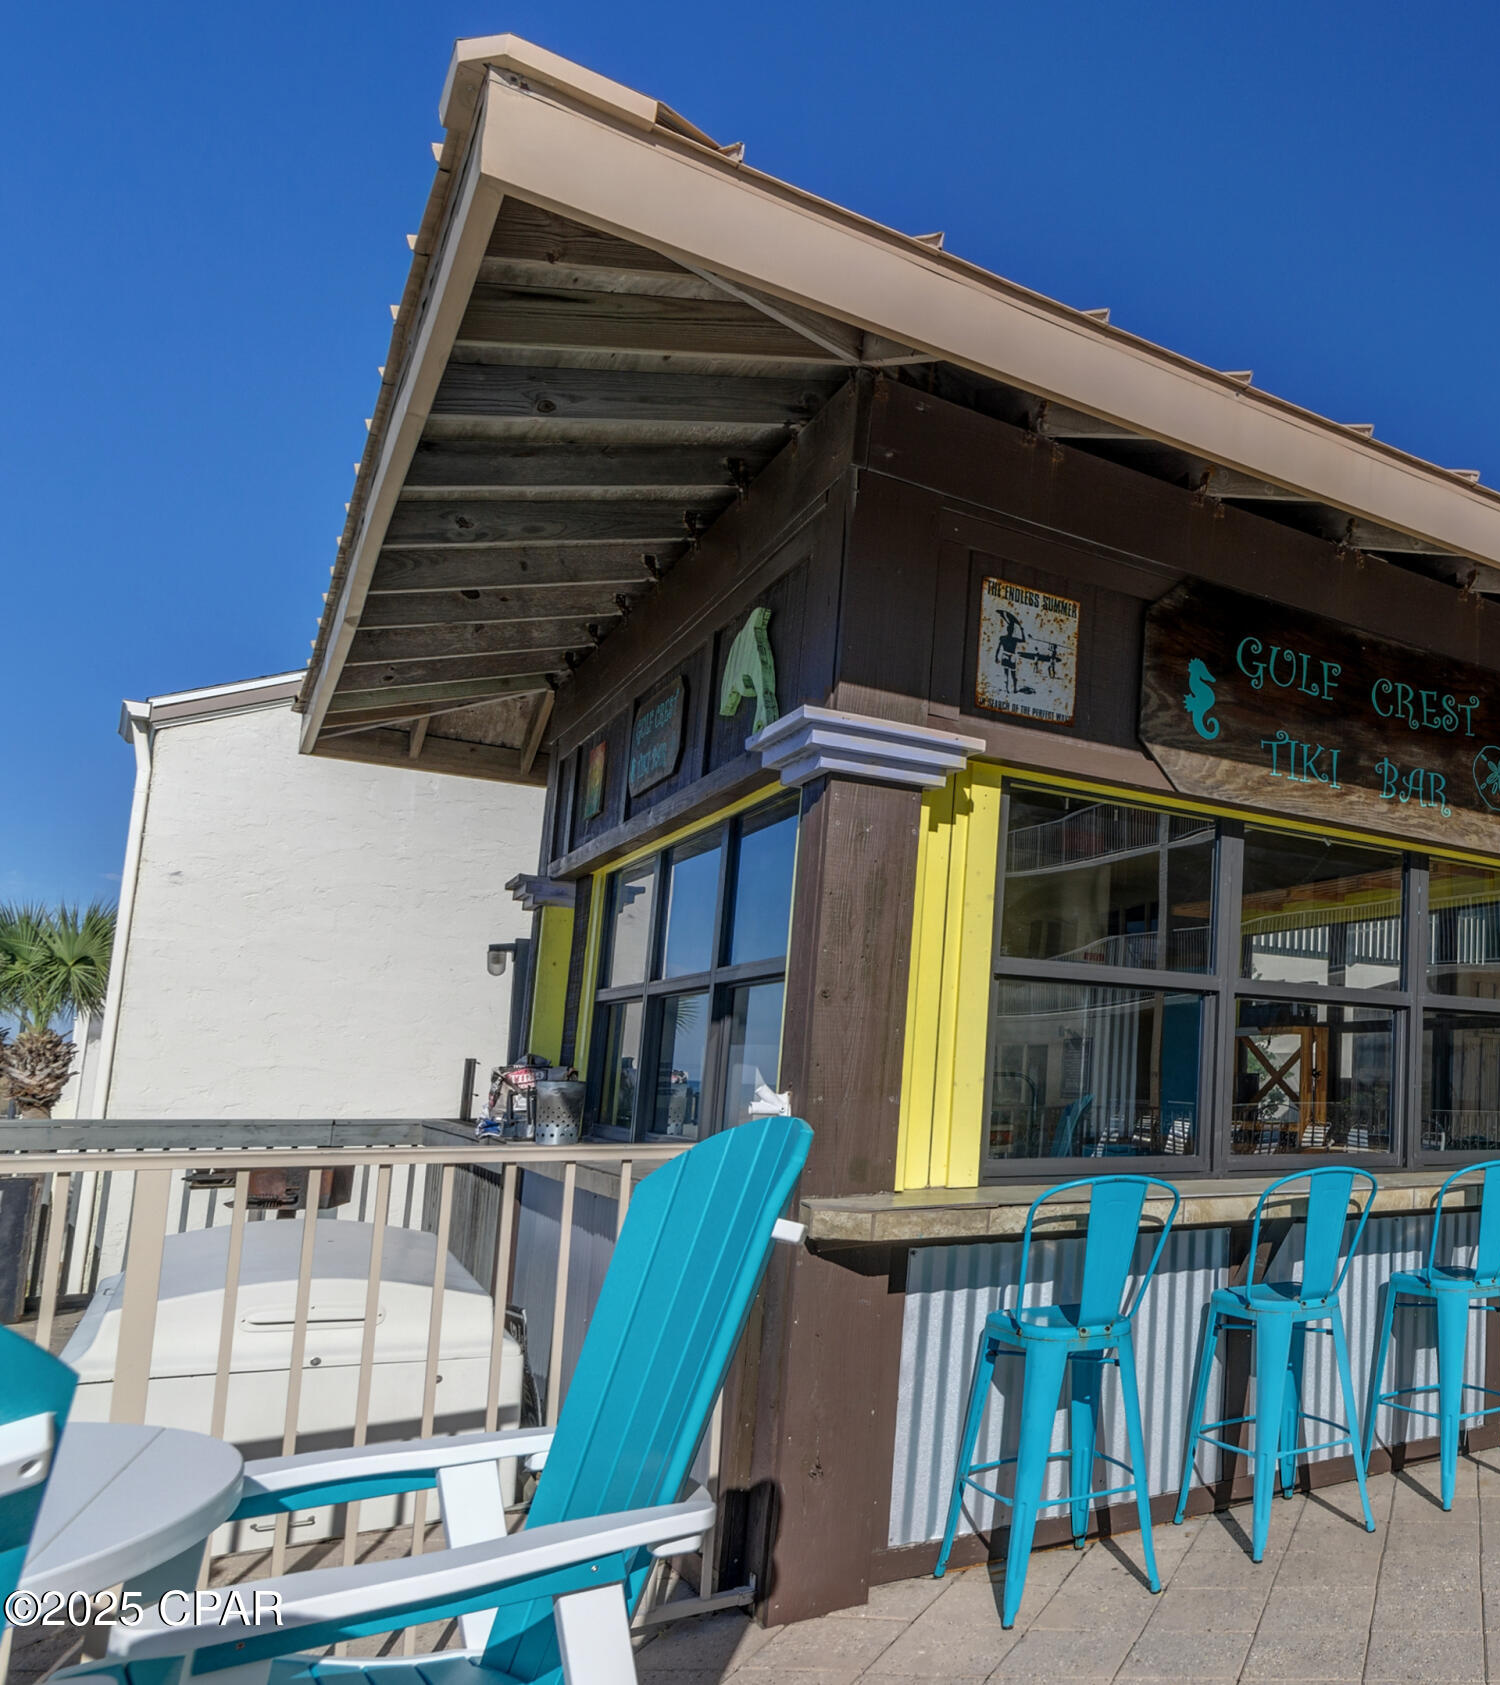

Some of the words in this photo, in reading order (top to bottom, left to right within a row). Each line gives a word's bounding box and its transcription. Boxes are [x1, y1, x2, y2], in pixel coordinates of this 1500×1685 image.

[986, 580, 1002, 598] THE
[1004, 584, 1040, 609] ENDLESS
[1042, 594, 1077, 618] SUMMER
[1236, 636, 1342, 701] GULF
[1371, 678, 1480, 737] CREST
[1261, 730, 1341, 789] TIKI
[1375, 757, 1451, 818] BAR
